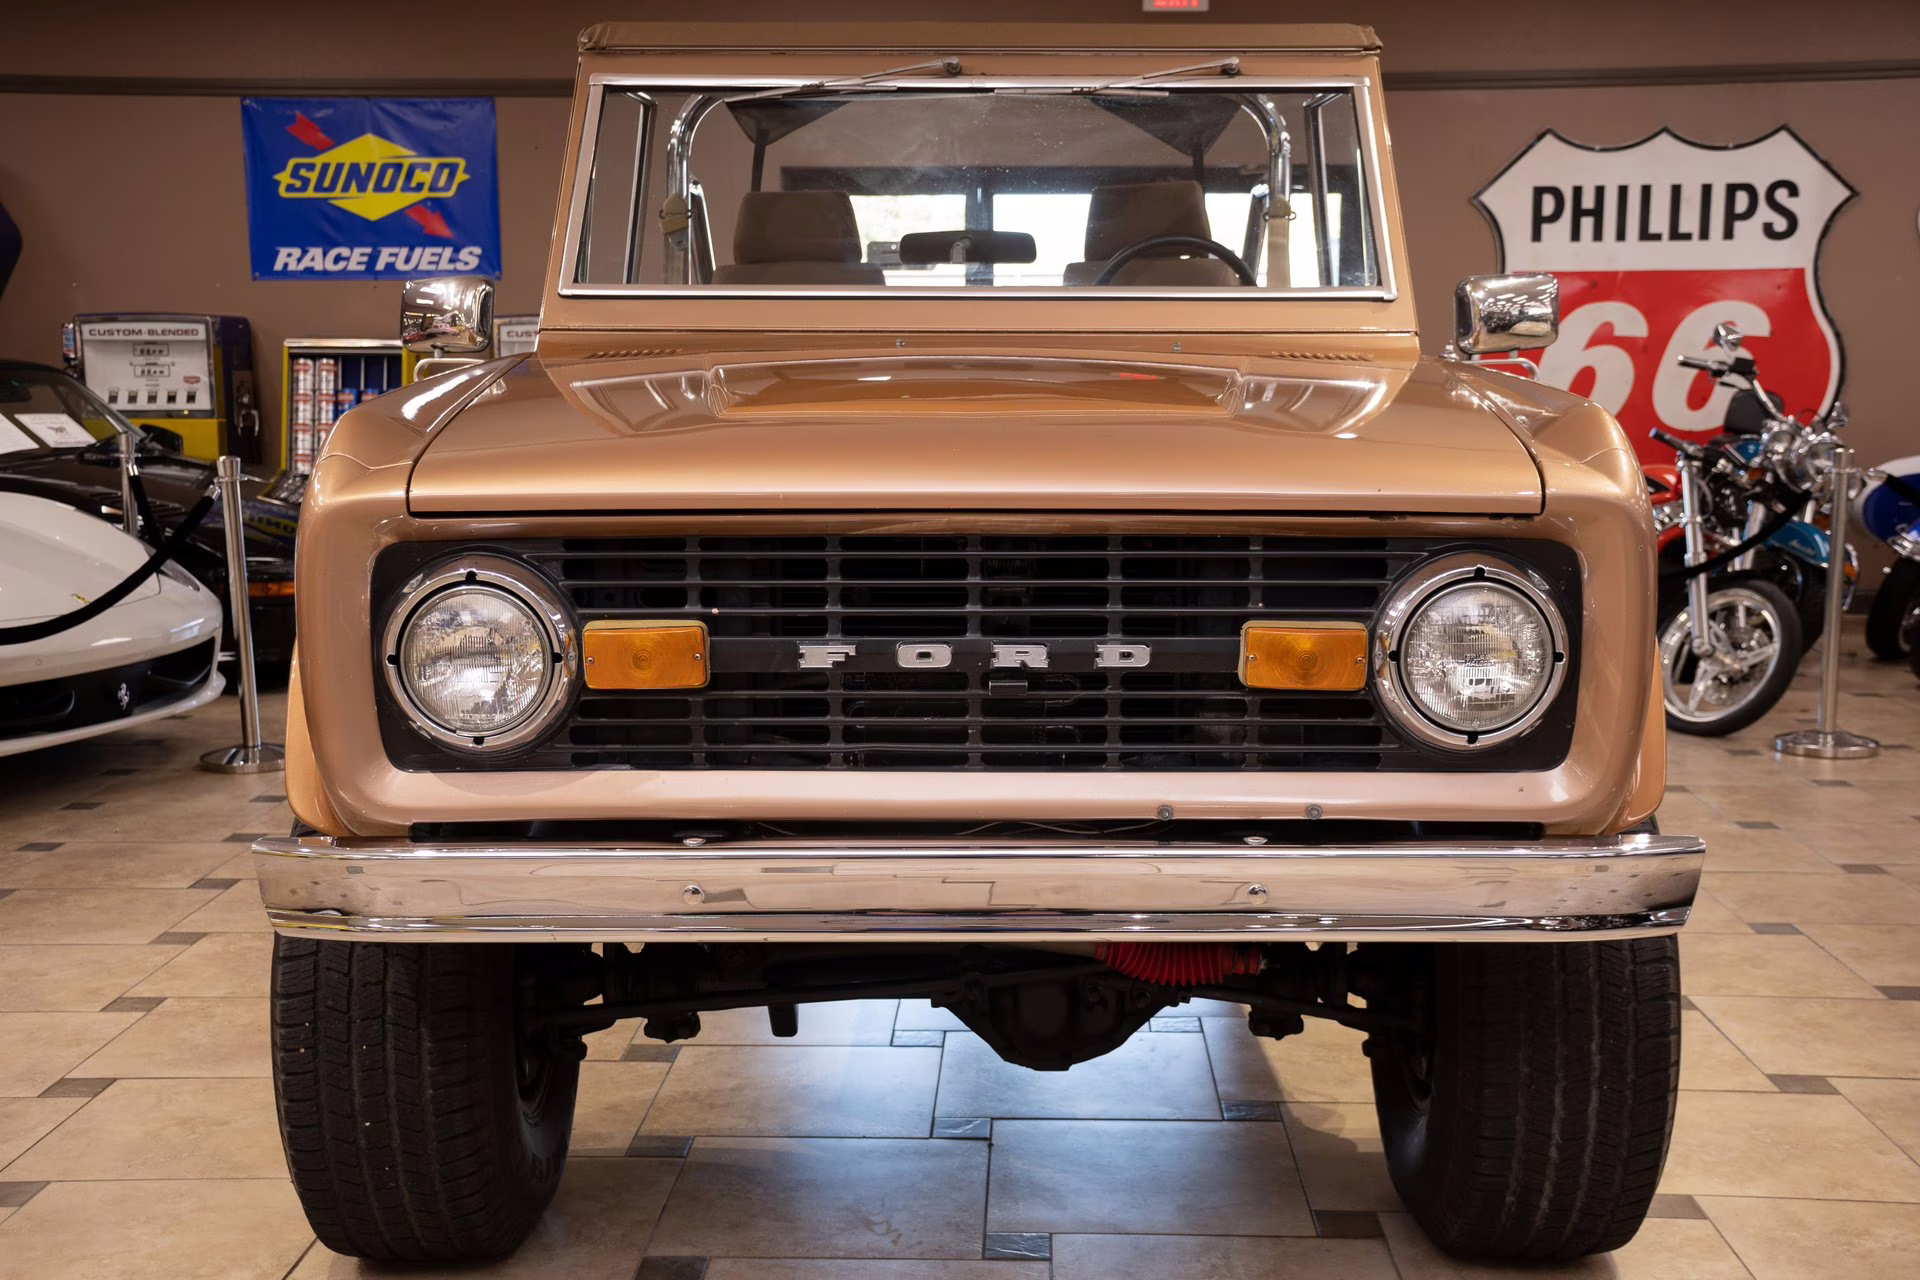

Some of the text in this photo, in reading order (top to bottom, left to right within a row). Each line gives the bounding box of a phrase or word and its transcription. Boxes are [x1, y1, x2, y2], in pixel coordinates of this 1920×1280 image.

[284, 162, 460, 193] SUNOCO
[1530, 179, 1800, 242] PHILLIPS
[273, 246, 482, 271] RACE FUELS
[1538, 299, 1772, 432] 66
[798, 643, 1152, 669] FORD
